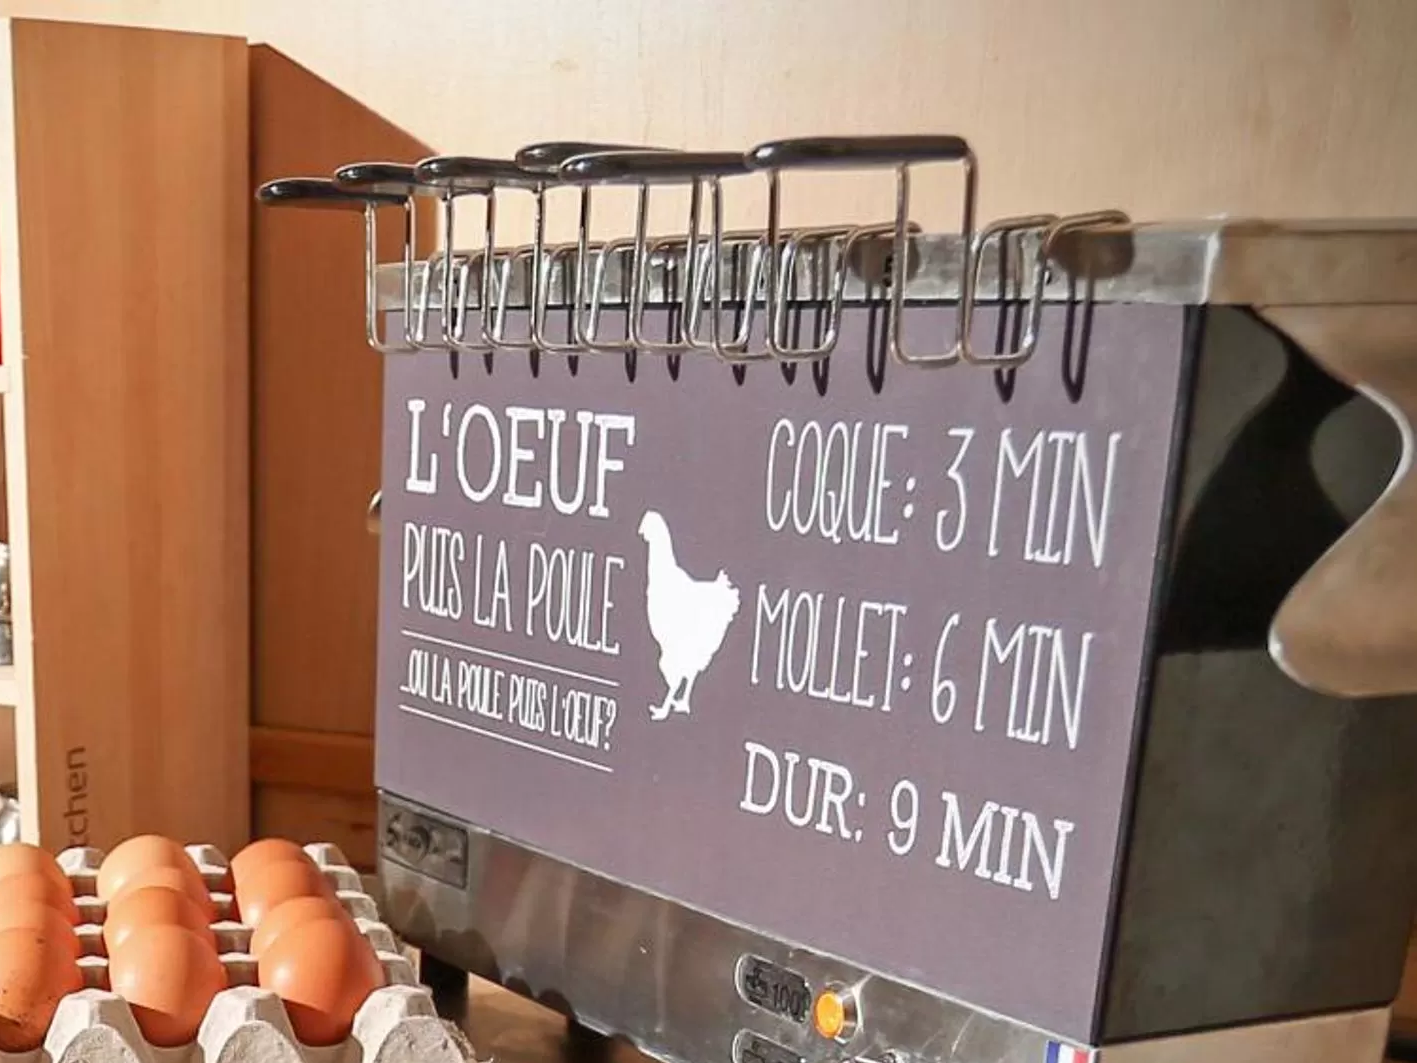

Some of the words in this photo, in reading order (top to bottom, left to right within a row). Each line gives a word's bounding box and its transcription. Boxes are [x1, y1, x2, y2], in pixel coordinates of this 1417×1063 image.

[405, 399, 636, 518] L'OEUF
[766, 418, 916, 545] COQUE:
[936, 428, 975, 551] 3
[988, 428, 1122, 568] MIN
[402, 521, 466, 621] PUIS
[473, 533, 513, 632] LA
[526, 542, 625, 655] POULE
[431, 653, 454, 706] LA
[457, 660, 505, 721] POULE
[508, 674, 547, 733] PUIS
[550, 685, 618, 751] L'OEUF?
[751, 583, 914, 713] MOLLET:
[932, 612, 961, 724] 6
[974, 618, 1094, 750] MIN
[739, 740, 866, 843] DUR:
[887, 779, 920, 856] 9
[935, 790, 1076, 901] MIN
